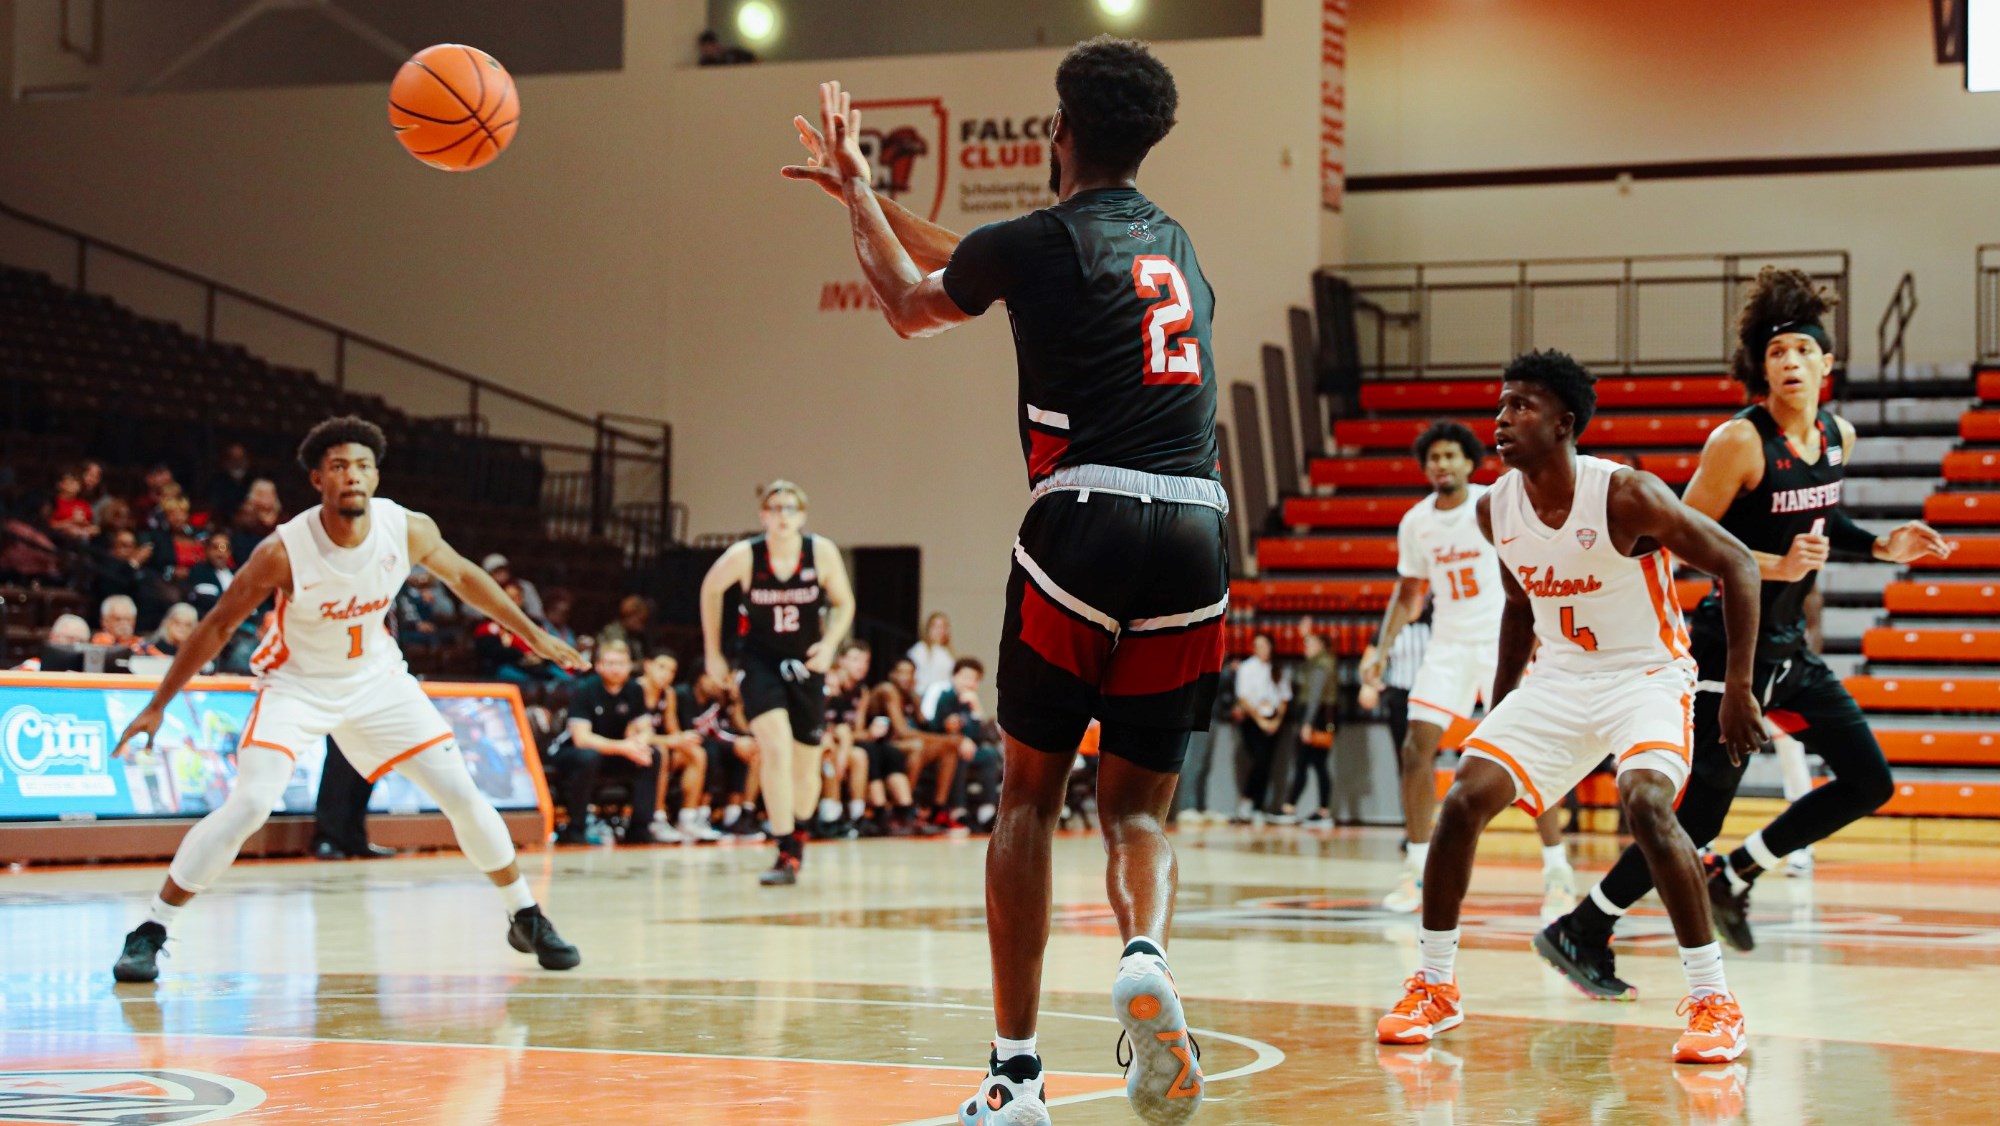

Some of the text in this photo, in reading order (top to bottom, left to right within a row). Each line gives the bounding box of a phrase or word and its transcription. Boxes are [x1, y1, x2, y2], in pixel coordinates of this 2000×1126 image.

[1321, 78, 1345, 178] THE
[959, 142, 1043, 170] CLUB
[1131, 254, 1202, 386] 2
[1446, 567, 1480, 600] 15
[1518, 565, 1602, 597] Falcons
[319, 595, 390, 621] Falcons
[773, 605, 800, 632] 12
[347, 624, 363, 660] 1
[1559, 606, 1598, 652] 4
[4, 706, 105, 773] City
